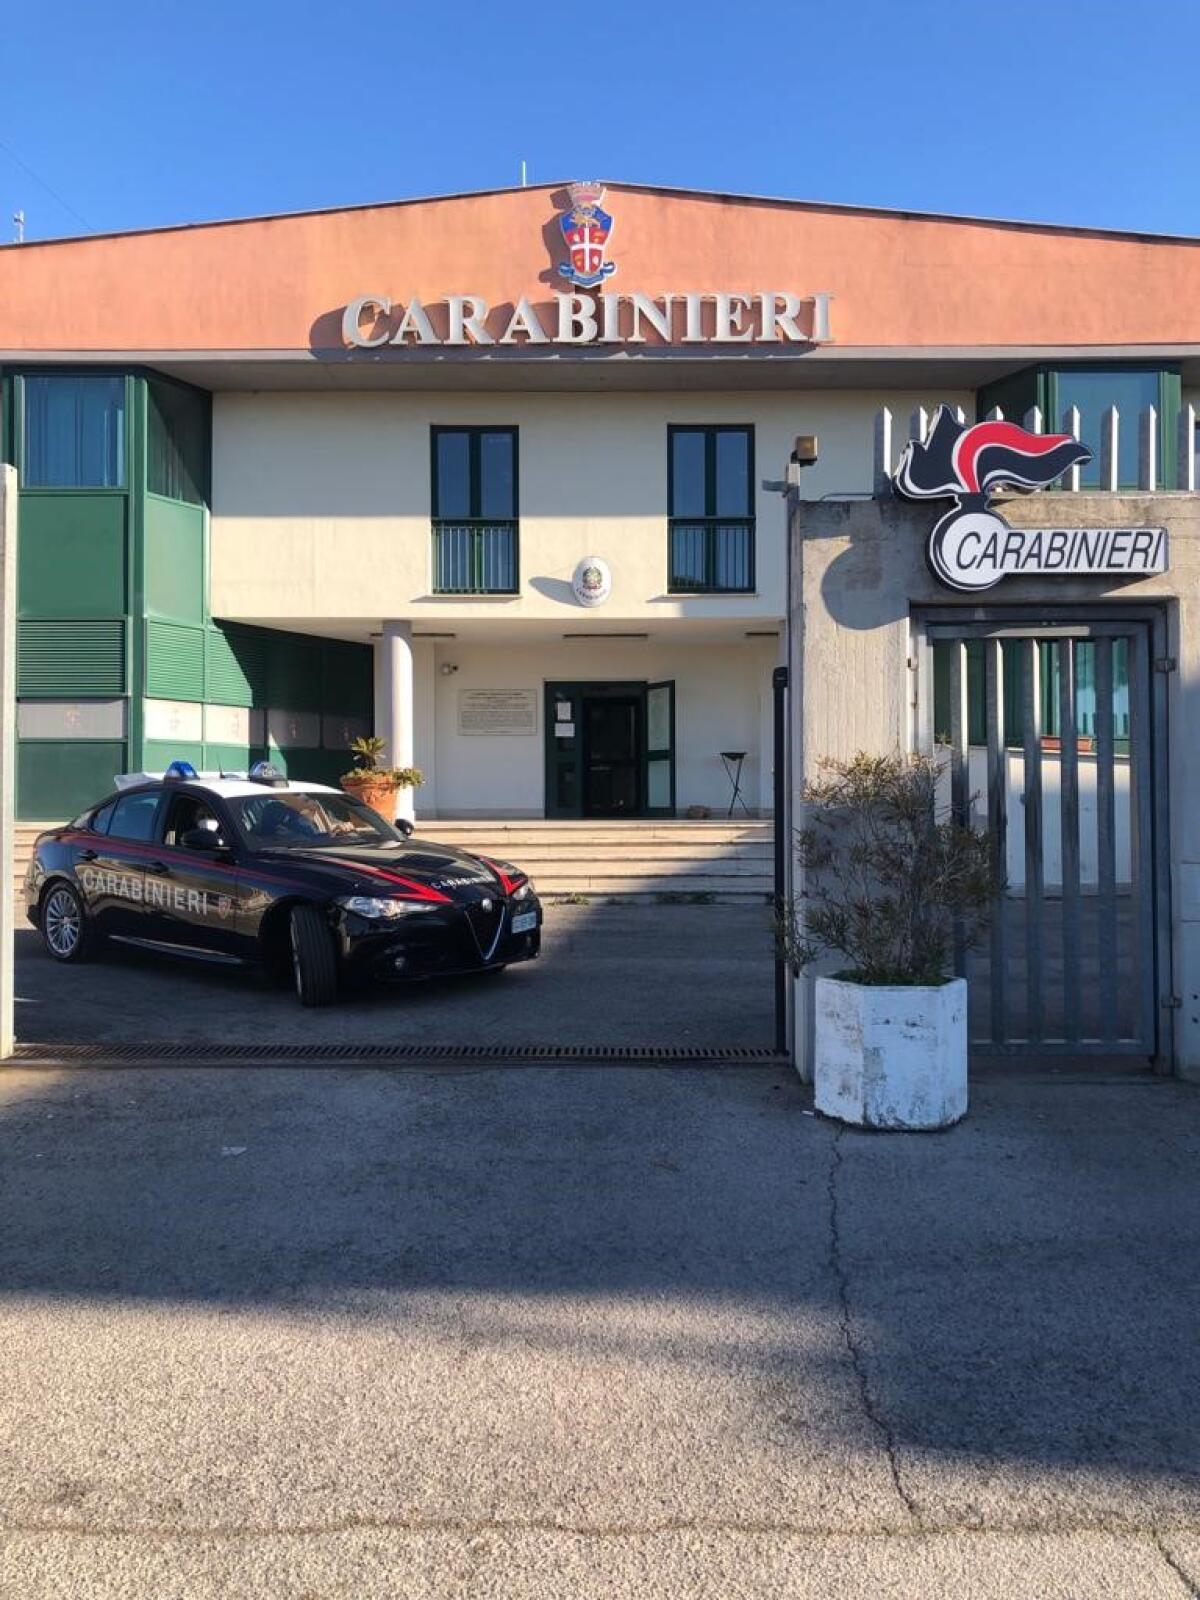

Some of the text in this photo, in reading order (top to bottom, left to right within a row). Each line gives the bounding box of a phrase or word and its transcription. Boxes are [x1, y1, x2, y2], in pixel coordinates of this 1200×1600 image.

[341, 290, 833, 349] CARABINIERI
[956, 530, 1163, 570] CARABINIERI
[82, 868, 208, 916] CARABINIERI
